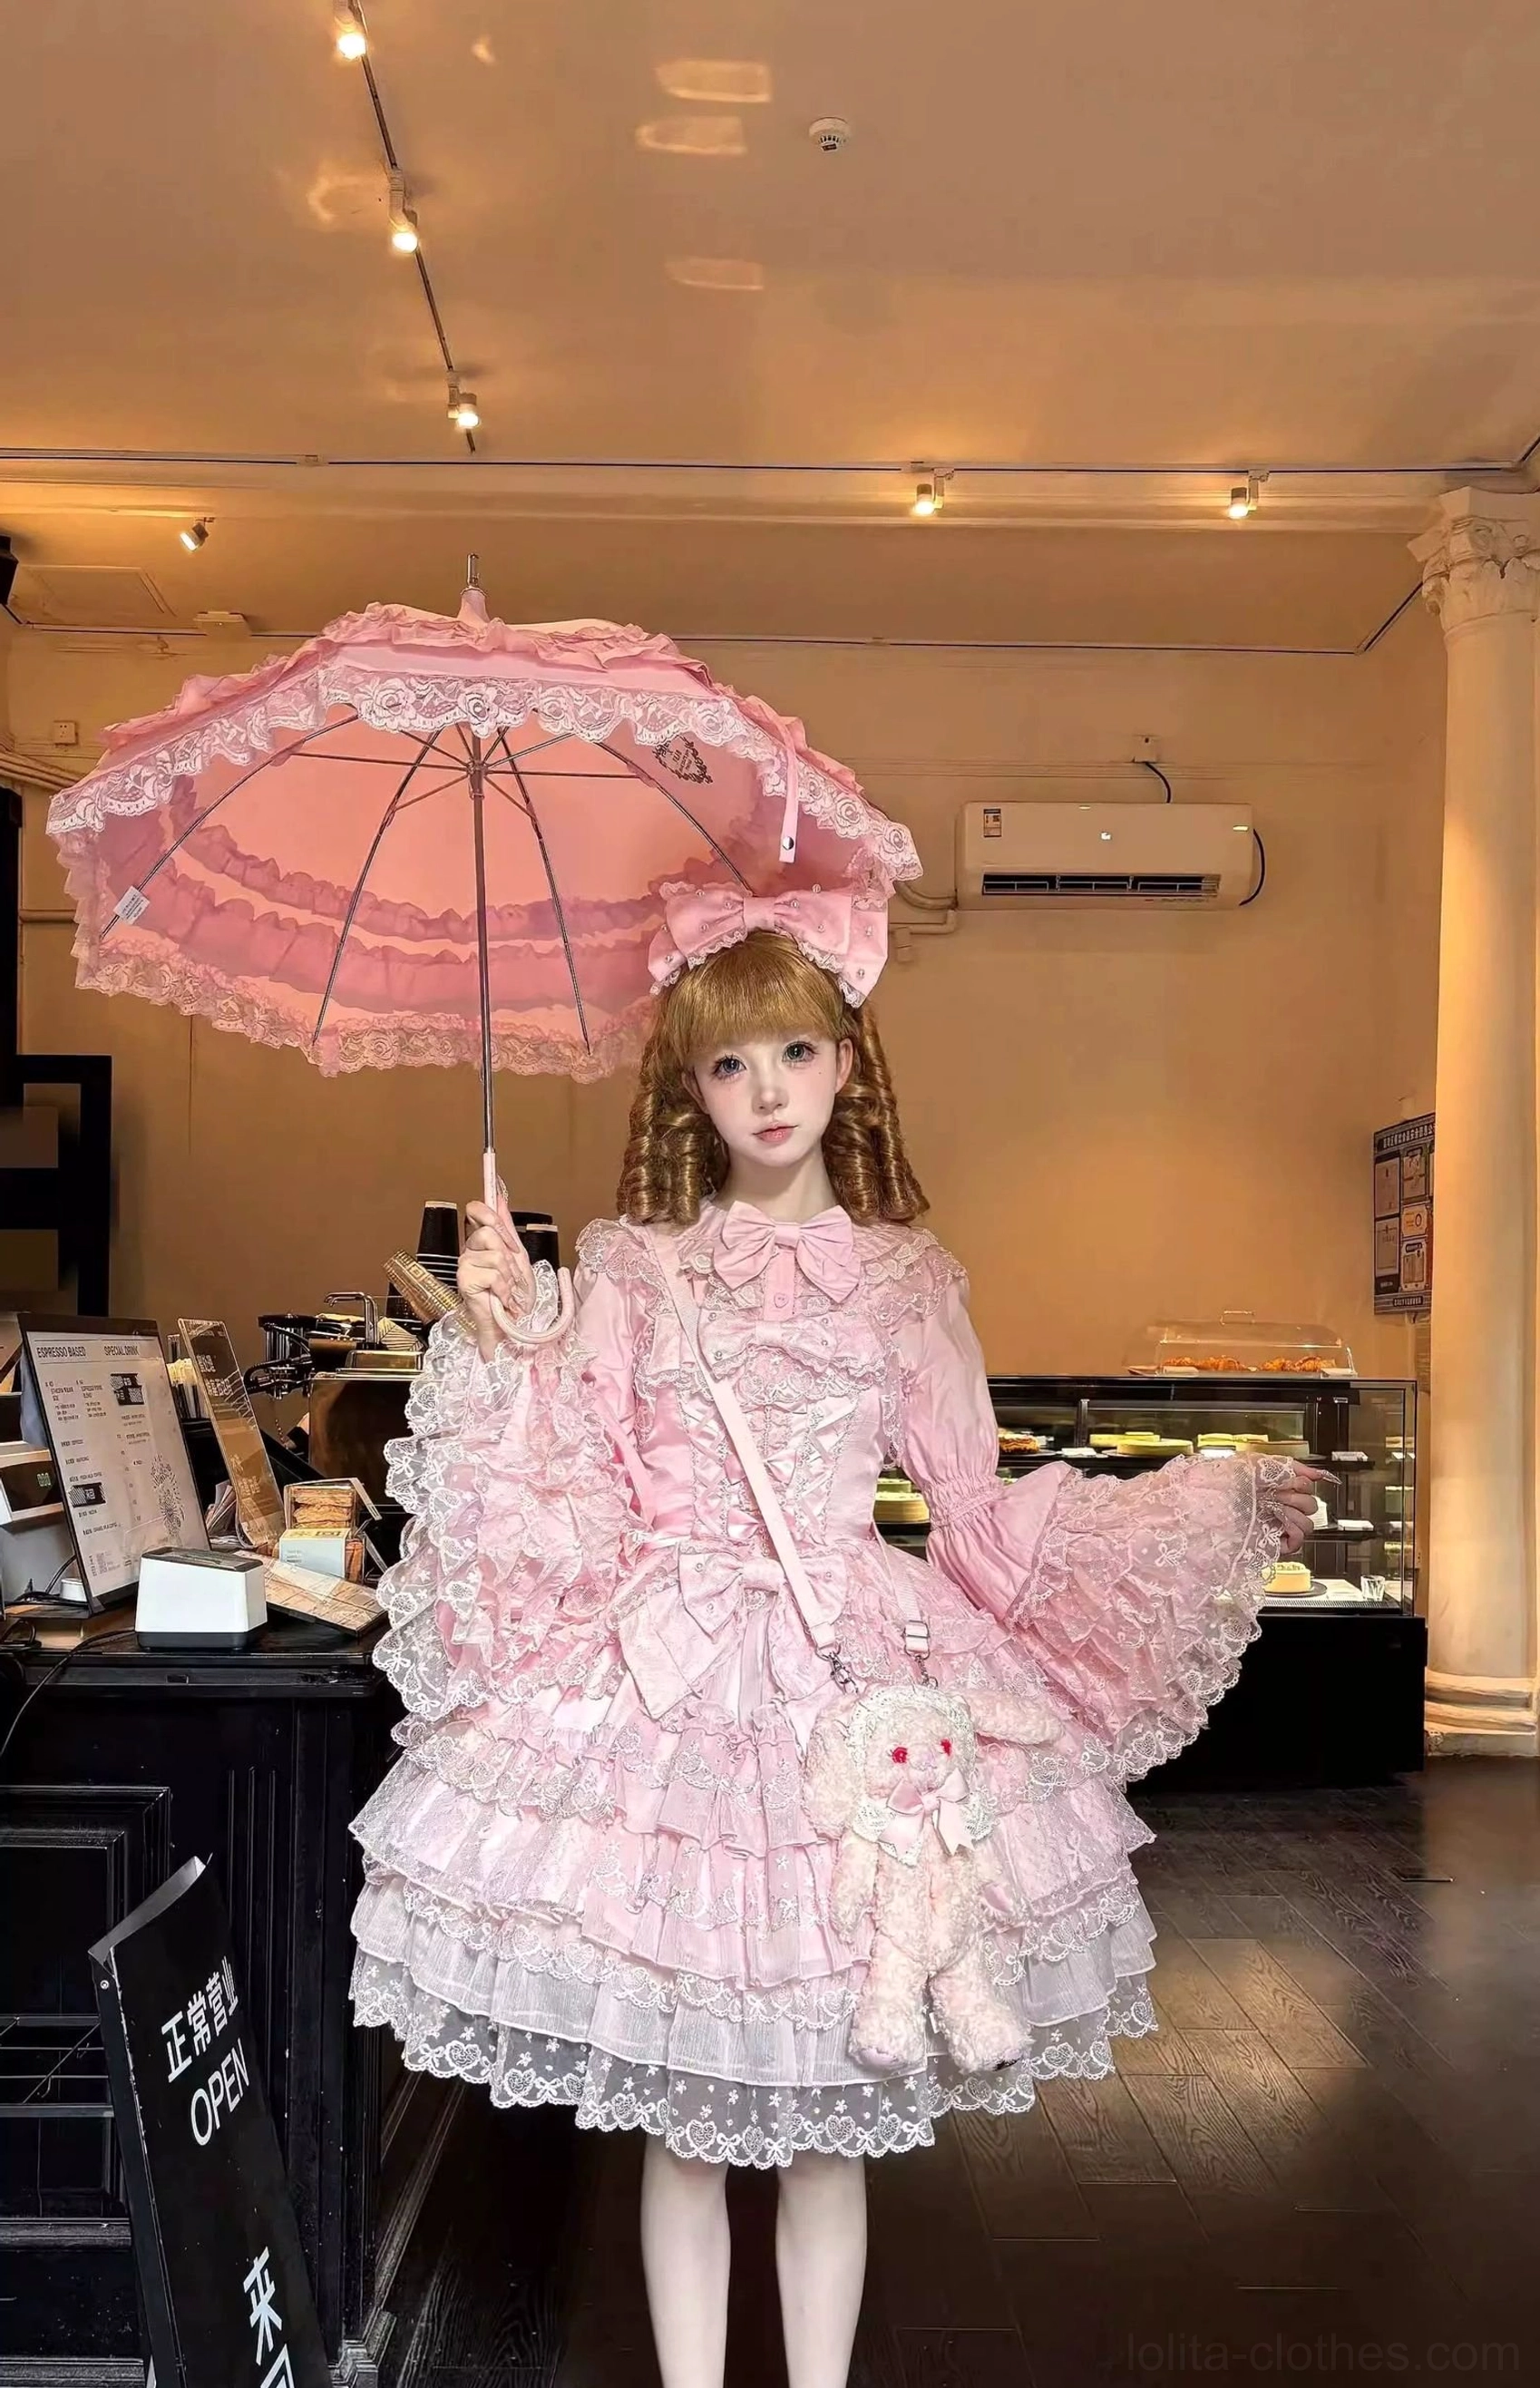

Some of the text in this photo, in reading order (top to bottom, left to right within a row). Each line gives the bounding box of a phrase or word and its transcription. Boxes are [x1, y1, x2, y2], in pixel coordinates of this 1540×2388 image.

[36, 1346, 86, 1358] ESPRESSO BASED
[103, 1345, 140, 1356] SPECIAL DRINK
[161, 1955, 239, 2083] 正常营业
[190, 2037, 249, 2146] OPEN
